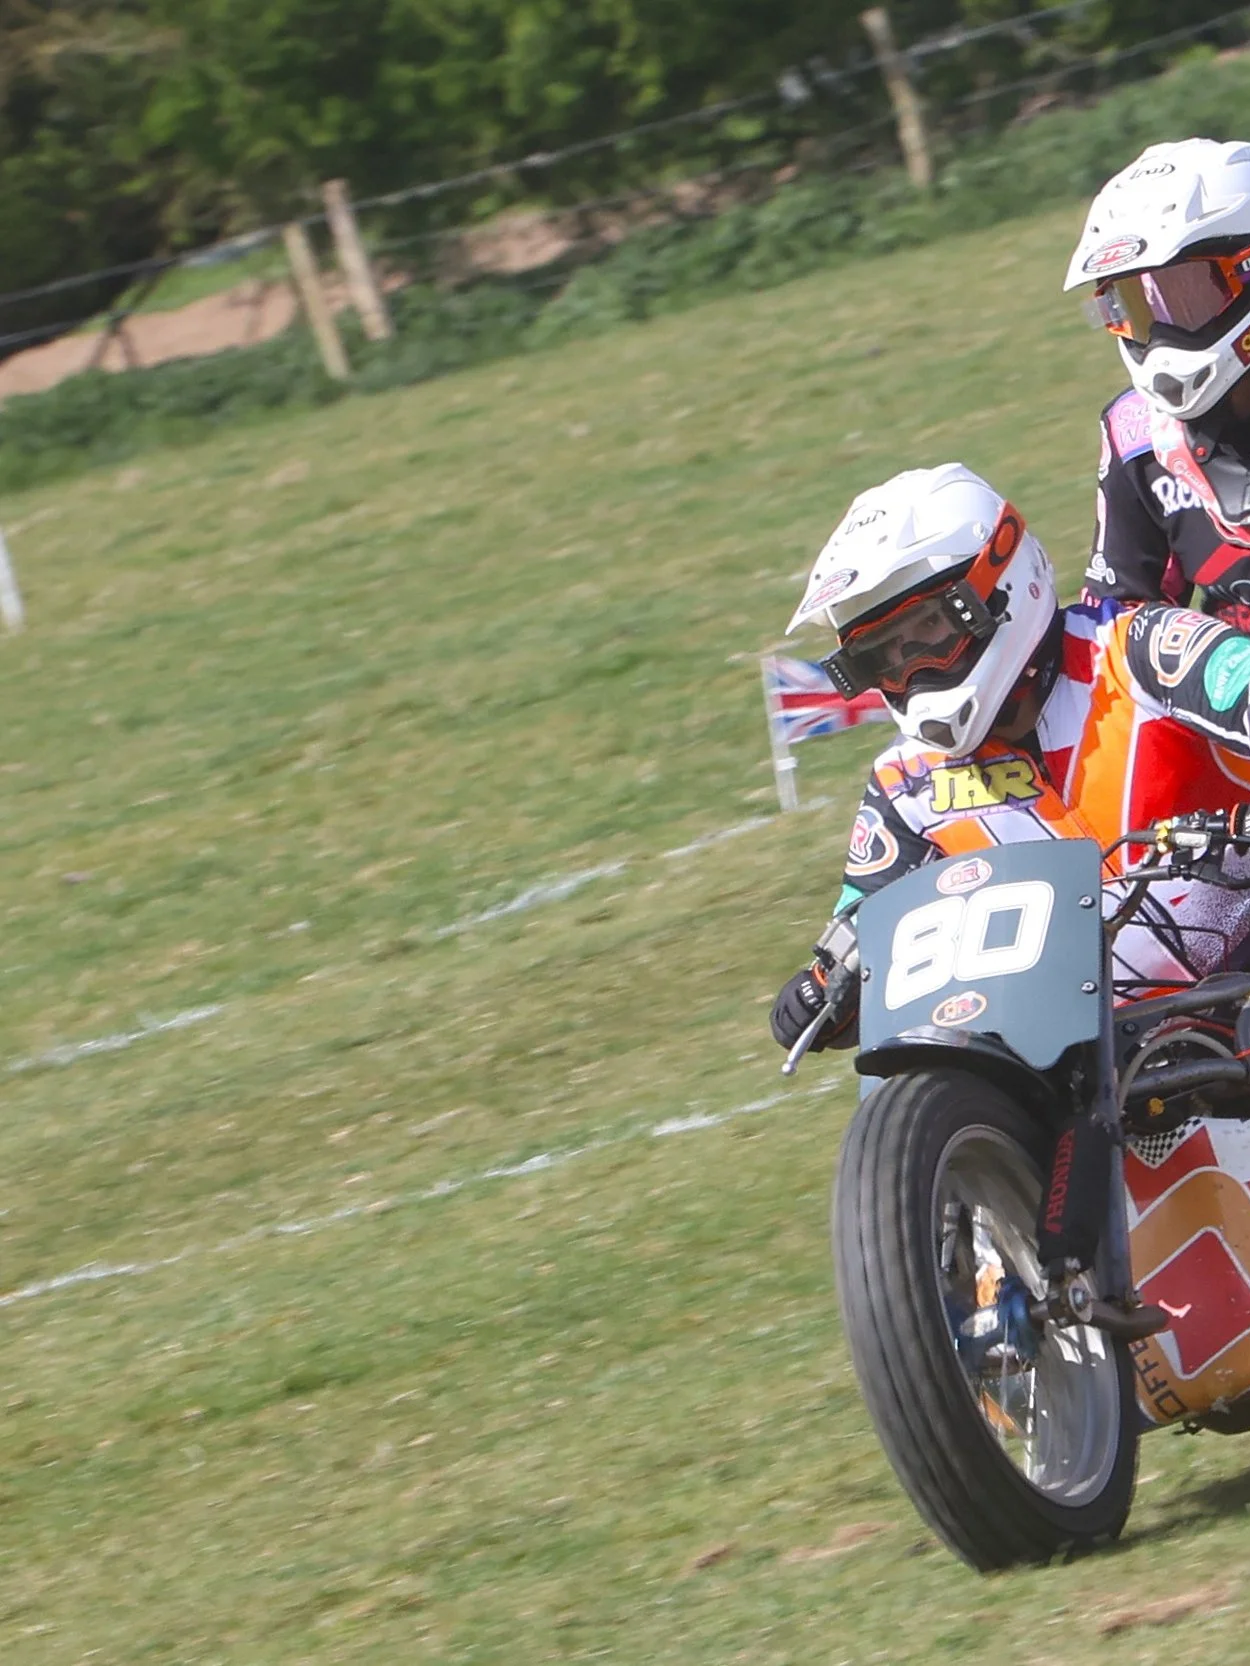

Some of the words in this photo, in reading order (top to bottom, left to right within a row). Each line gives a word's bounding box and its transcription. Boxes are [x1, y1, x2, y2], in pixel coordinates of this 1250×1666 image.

[929, 759, 1045, 814] JHR
[885, 880, 1055, 1011] 80
[1044, 1127, 1076, 1233] HONDA
